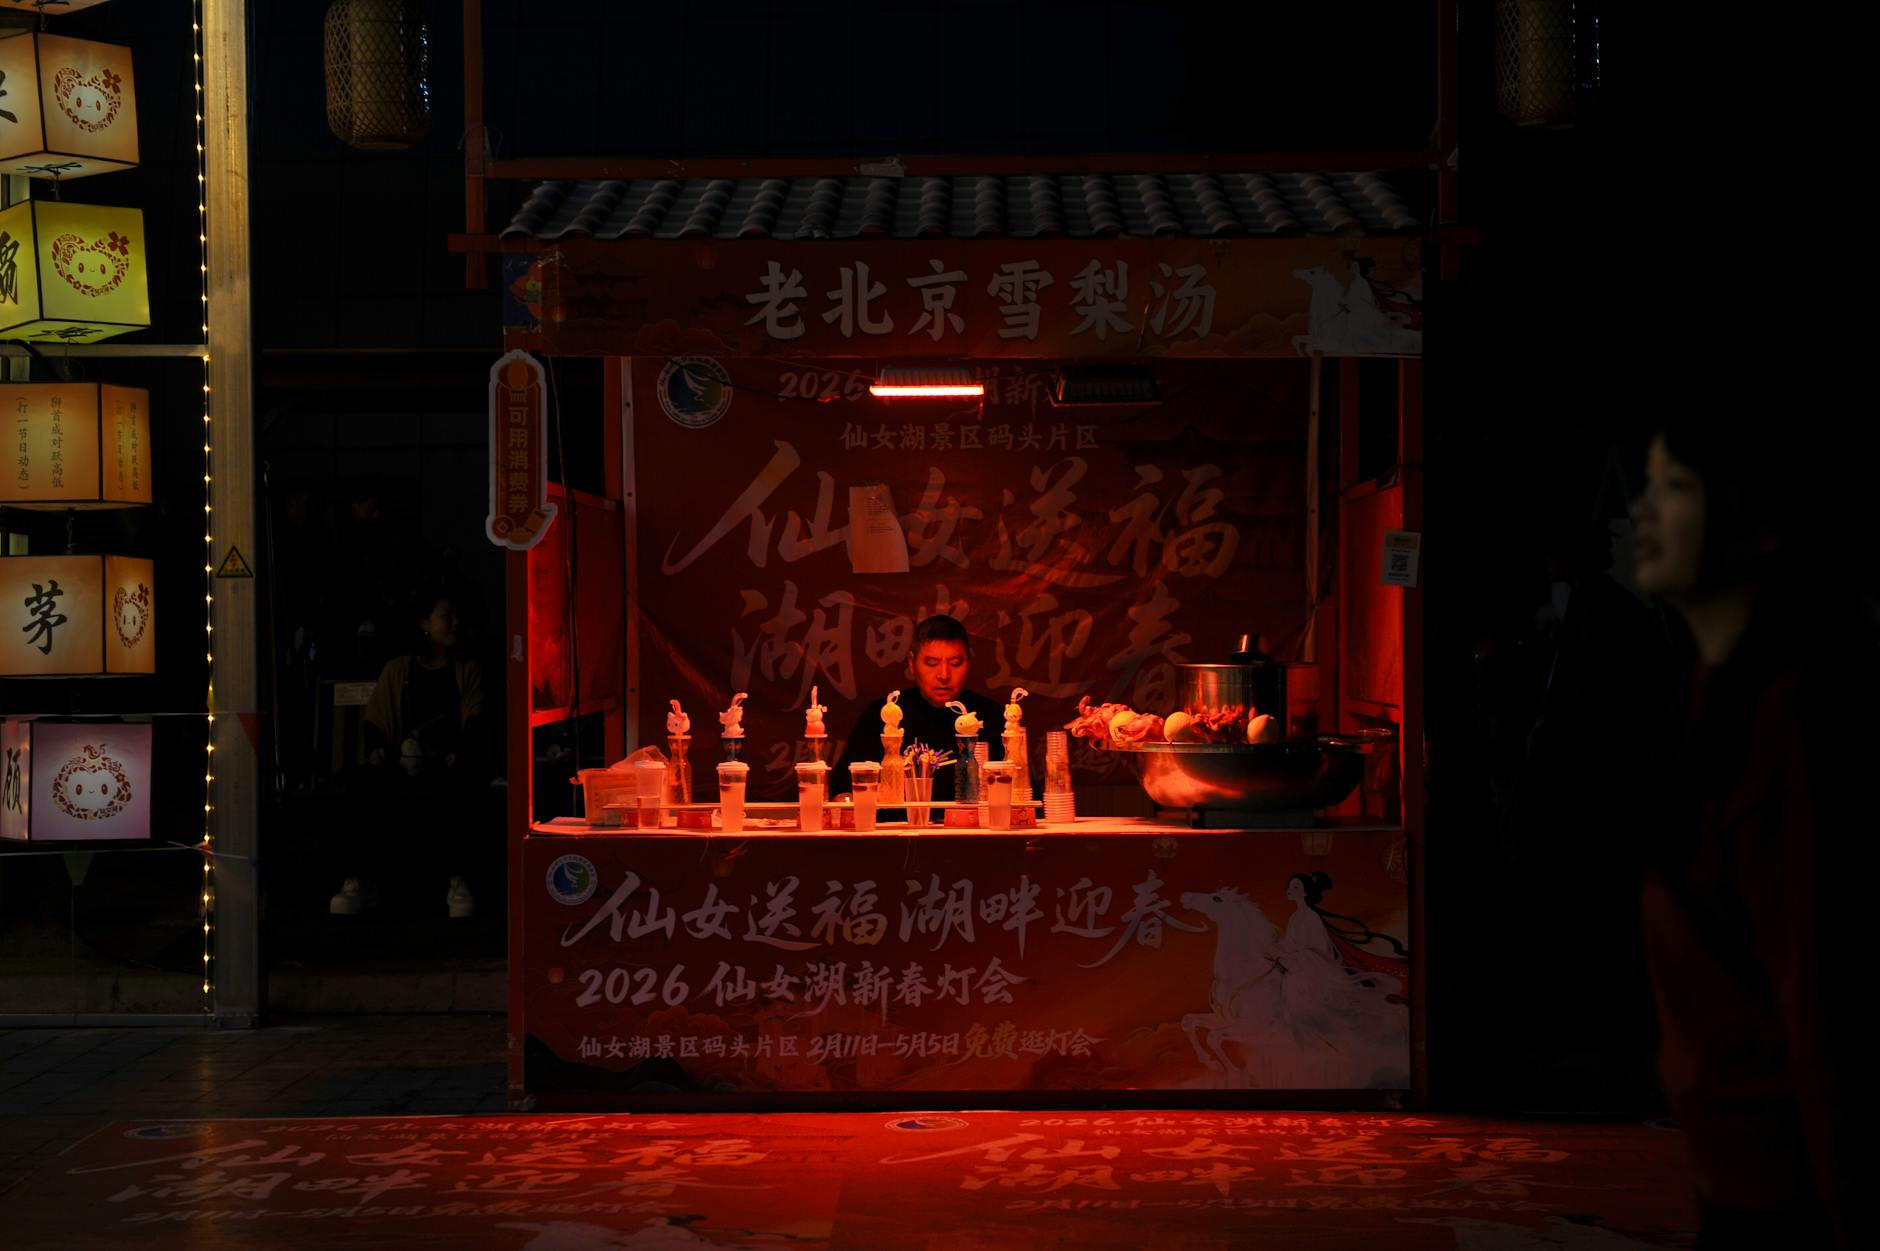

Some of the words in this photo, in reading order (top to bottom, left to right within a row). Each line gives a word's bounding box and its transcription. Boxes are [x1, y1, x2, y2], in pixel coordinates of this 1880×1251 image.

[744, 258, 1217, 341] 老北京雪梨汤
[840, 422, 1100, 451] 仙女湖景区码头片区
[660, 439, 1241, 588] 仙女送福
[22, 579, 67, 655] 茅
[560, 868, 1210, 969] 仙女送福湖畔迎春
[575, 962, 691, 1009] 2026
[701, 955, 1031, 1028] 仙女湖新春灯会
[577, 1032, 800, 1061] 仙女湖景区码头片区
